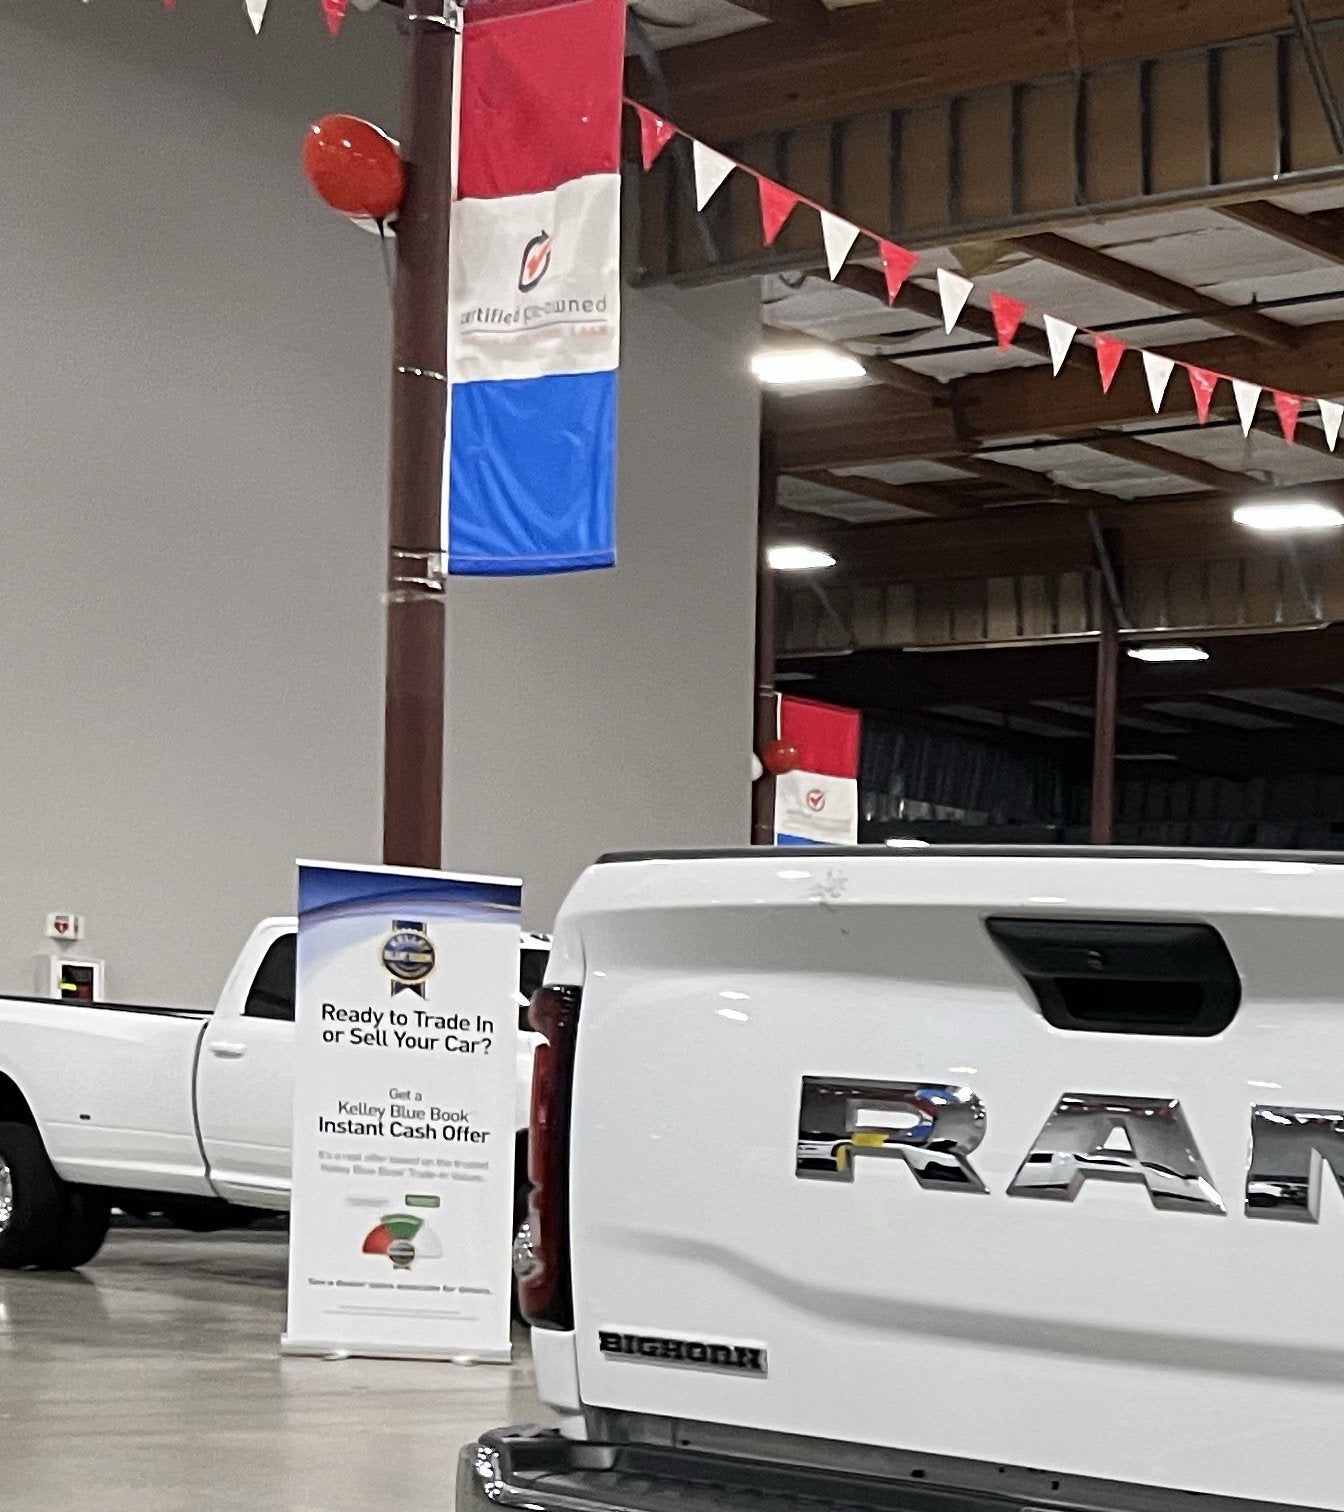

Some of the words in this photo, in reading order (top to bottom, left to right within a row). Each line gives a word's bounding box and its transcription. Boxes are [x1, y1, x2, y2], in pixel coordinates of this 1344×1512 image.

[321, 1003, 384, 1028] Ready
[390, 1009, 408, 1026] to
[414, 1010, 471, 1031] Trade
[476, 1015, 494, 1033] In
[322, 1028, 343, 1043] or
[350, 1028, 388, 1047] Sell
[394, 1031, 439, 1051] Your
[445, 1035, 492, 1055] Car?
[389, 1088, 411, 1101] Get
[415, 1091, 423, 1101] a
[338, 1101, 385, 1120] Kelley
[390, 1104, 425, 1119] Blue
[430, 1106, 469, 1123] Book
[319, 1117, 384, 1136] Instant
[390, 1122, 437, 1140] Cash
[442, 1124, 490, 1143] Offer
